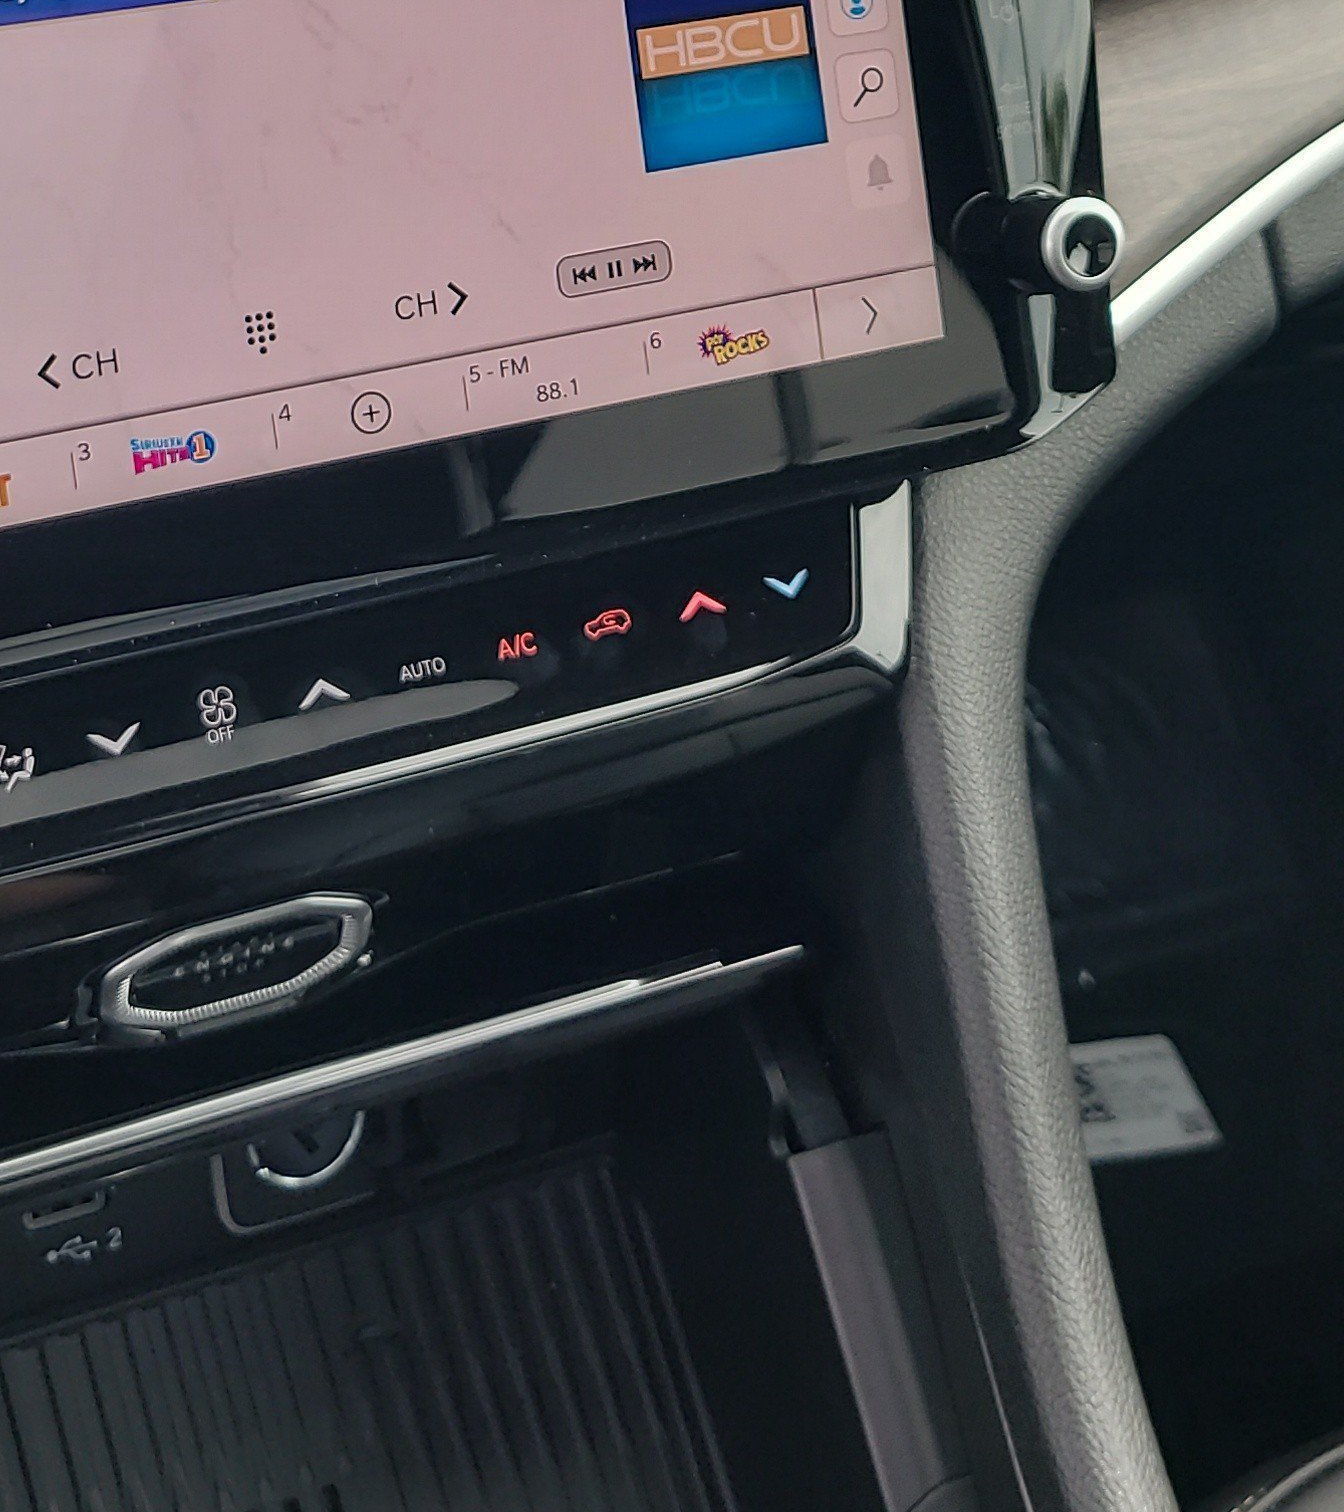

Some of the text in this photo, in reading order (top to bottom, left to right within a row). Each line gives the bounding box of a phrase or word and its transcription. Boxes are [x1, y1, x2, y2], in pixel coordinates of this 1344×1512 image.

[645, 13, 801, 72] HBCU
[394, 289, 439, 322] CH
[648, 331, 663, 351] 6
[713, 330, 769, 365] ROCKS
[71, 348, 120, 379] CH
[468, 364, 482, 385] 5
[498, 355, 532, 380] FM
[534, 379, 581, 404] 88.1
[277, 403, 293, 423] 4
[78, 441, 93, 462] 3
[497, 631, 538, 662] A/C
[399, 656, 447, 684] AUTO
[206, 725, 235, 745] OFF
[108, 1226, 123, 1250] 2
